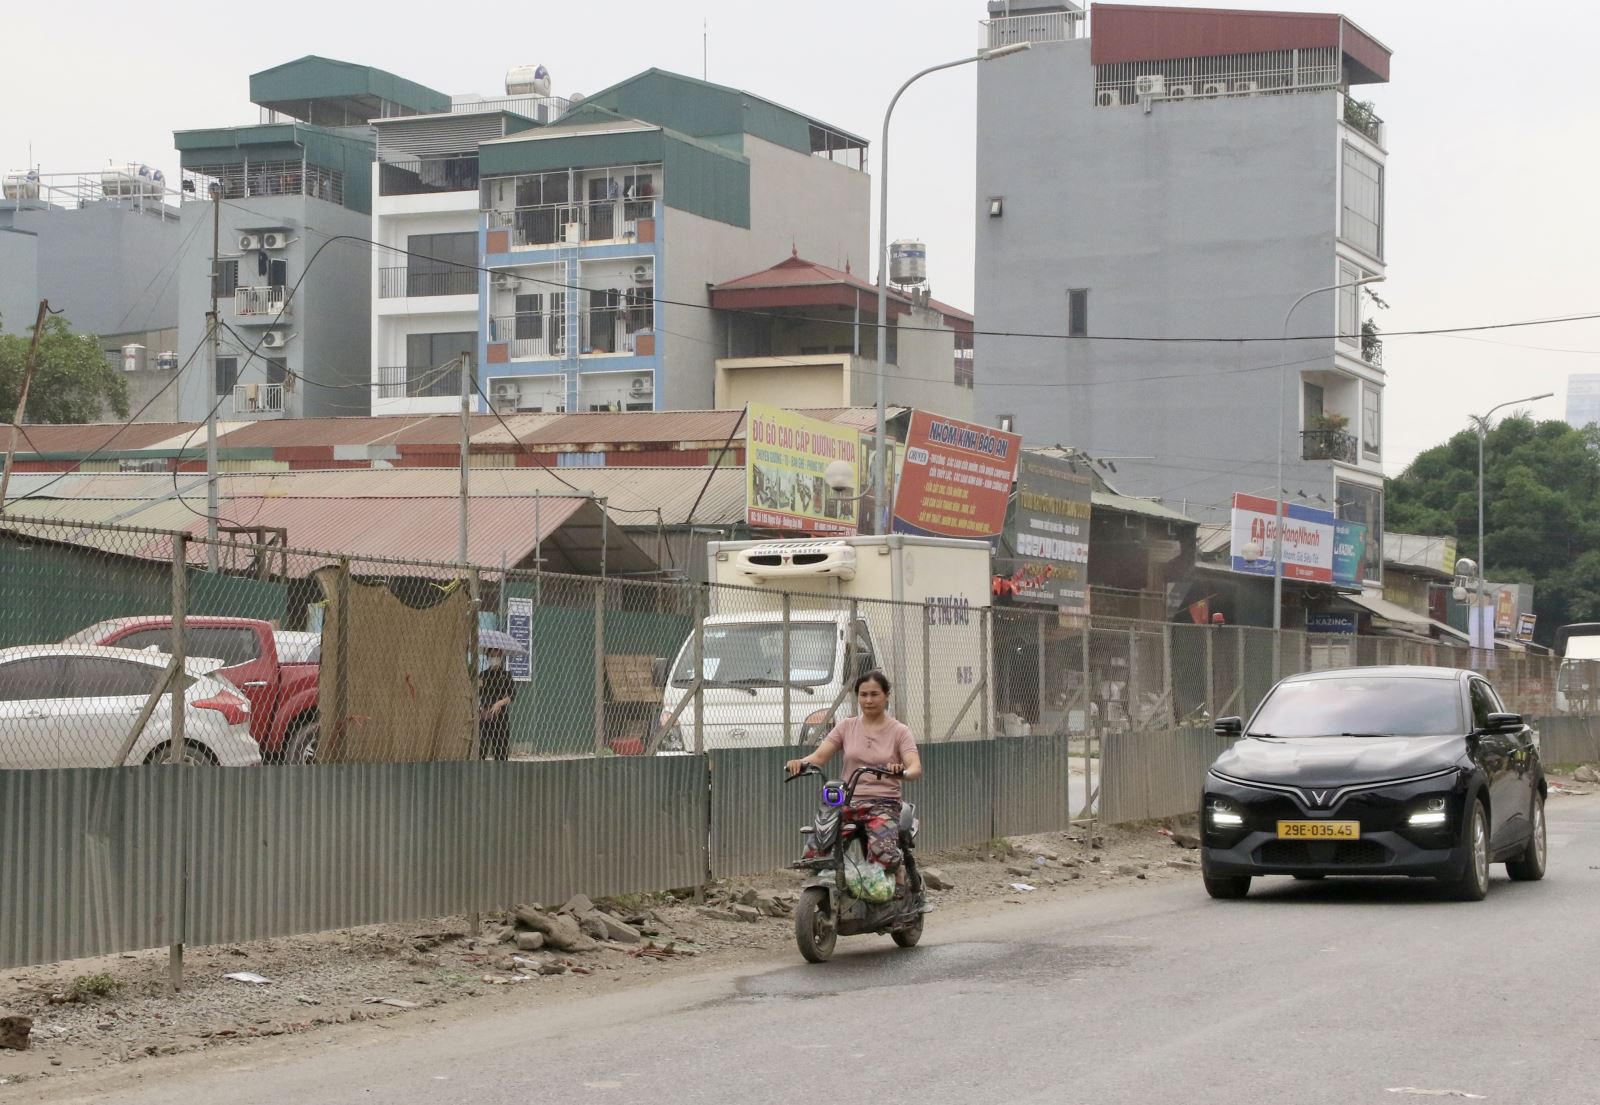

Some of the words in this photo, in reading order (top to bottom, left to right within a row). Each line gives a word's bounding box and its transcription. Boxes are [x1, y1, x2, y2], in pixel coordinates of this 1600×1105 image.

[779, 426, 793, 449] CAO
[796, 427, 810, 453] CẤP
[838, 439, 856, 462] THOA
[928, 420, 958, 446] NHÔM
[957, 425, 979, 450] KÍNH
[978, 429, 995, 454] BẢO
[994, 439, 1009, 458] AN
[954, 592, 969, 625] BÁO
[1284, 824, 1353, 837] 29E-035.45
